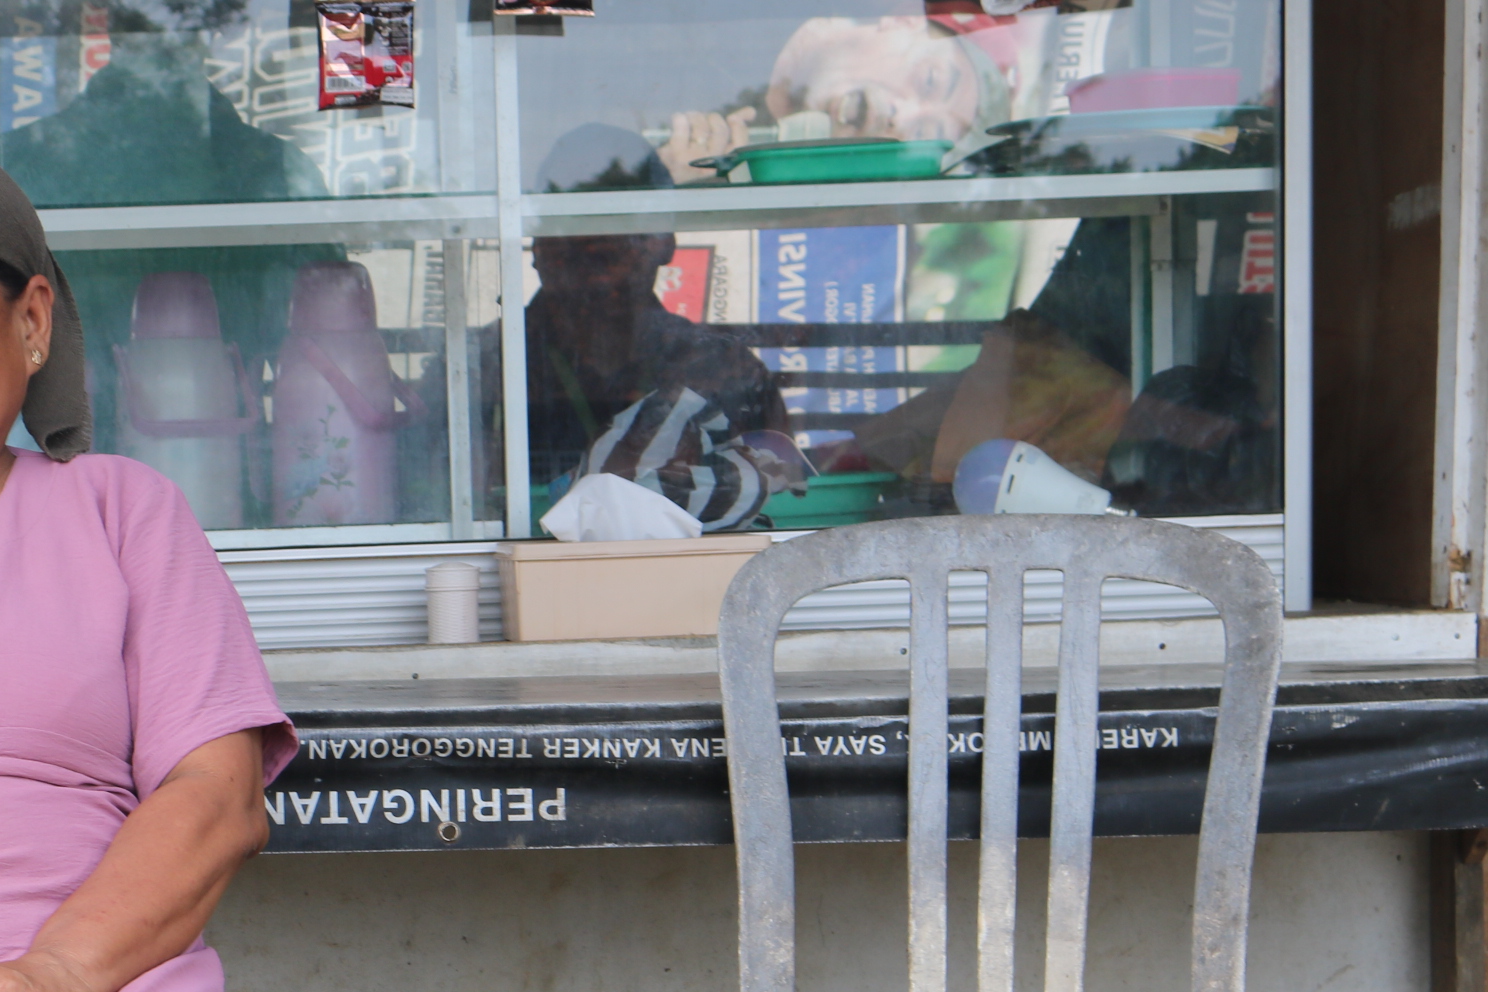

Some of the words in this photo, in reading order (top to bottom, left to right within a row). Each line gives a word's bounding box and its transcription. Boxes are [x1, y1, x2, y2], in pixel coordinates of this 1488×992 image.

[299, 737, 533, 760] TENGGOROKAN.
[543, 736, 661, 759] KANKER
[813, 733, 887, 756] SAYA
[1095, 726, 1179, 750] KARE
[263, 786, 567, 825] PERINGATAN
